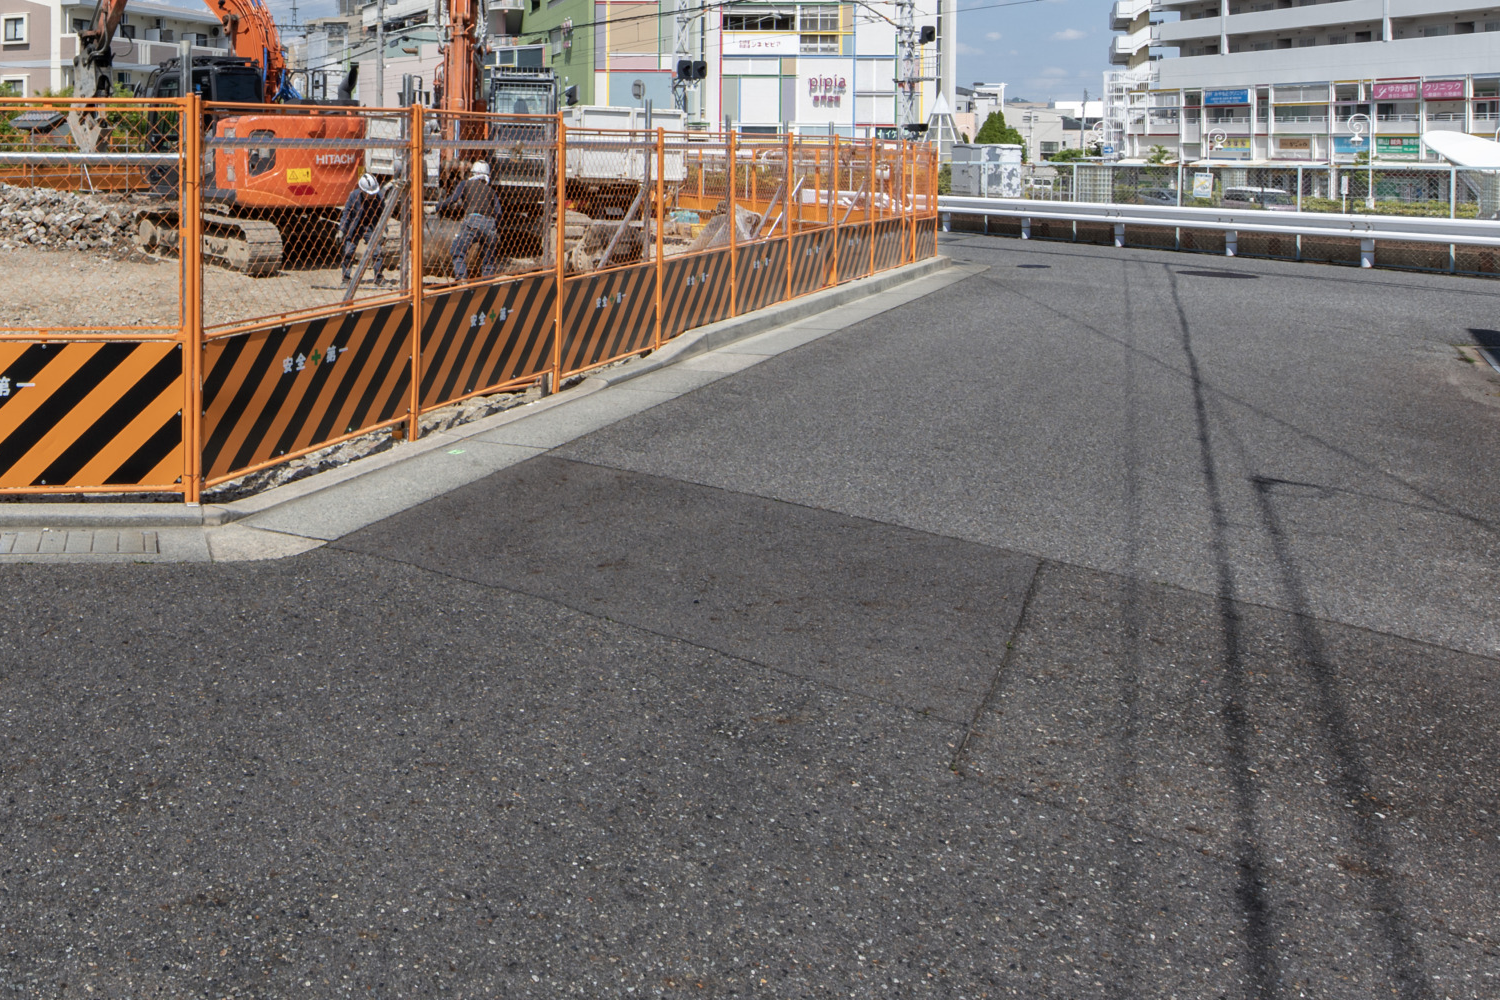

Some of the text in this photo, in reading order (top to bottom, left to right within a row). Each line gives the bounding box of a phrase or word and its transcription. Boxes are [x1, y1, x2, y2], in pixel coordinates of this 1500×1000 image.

[808, 74, 846, 91] pipia
[1424, 82, 1461, 91] クリニック
[282, 345, 348, 374] 安全 第一
